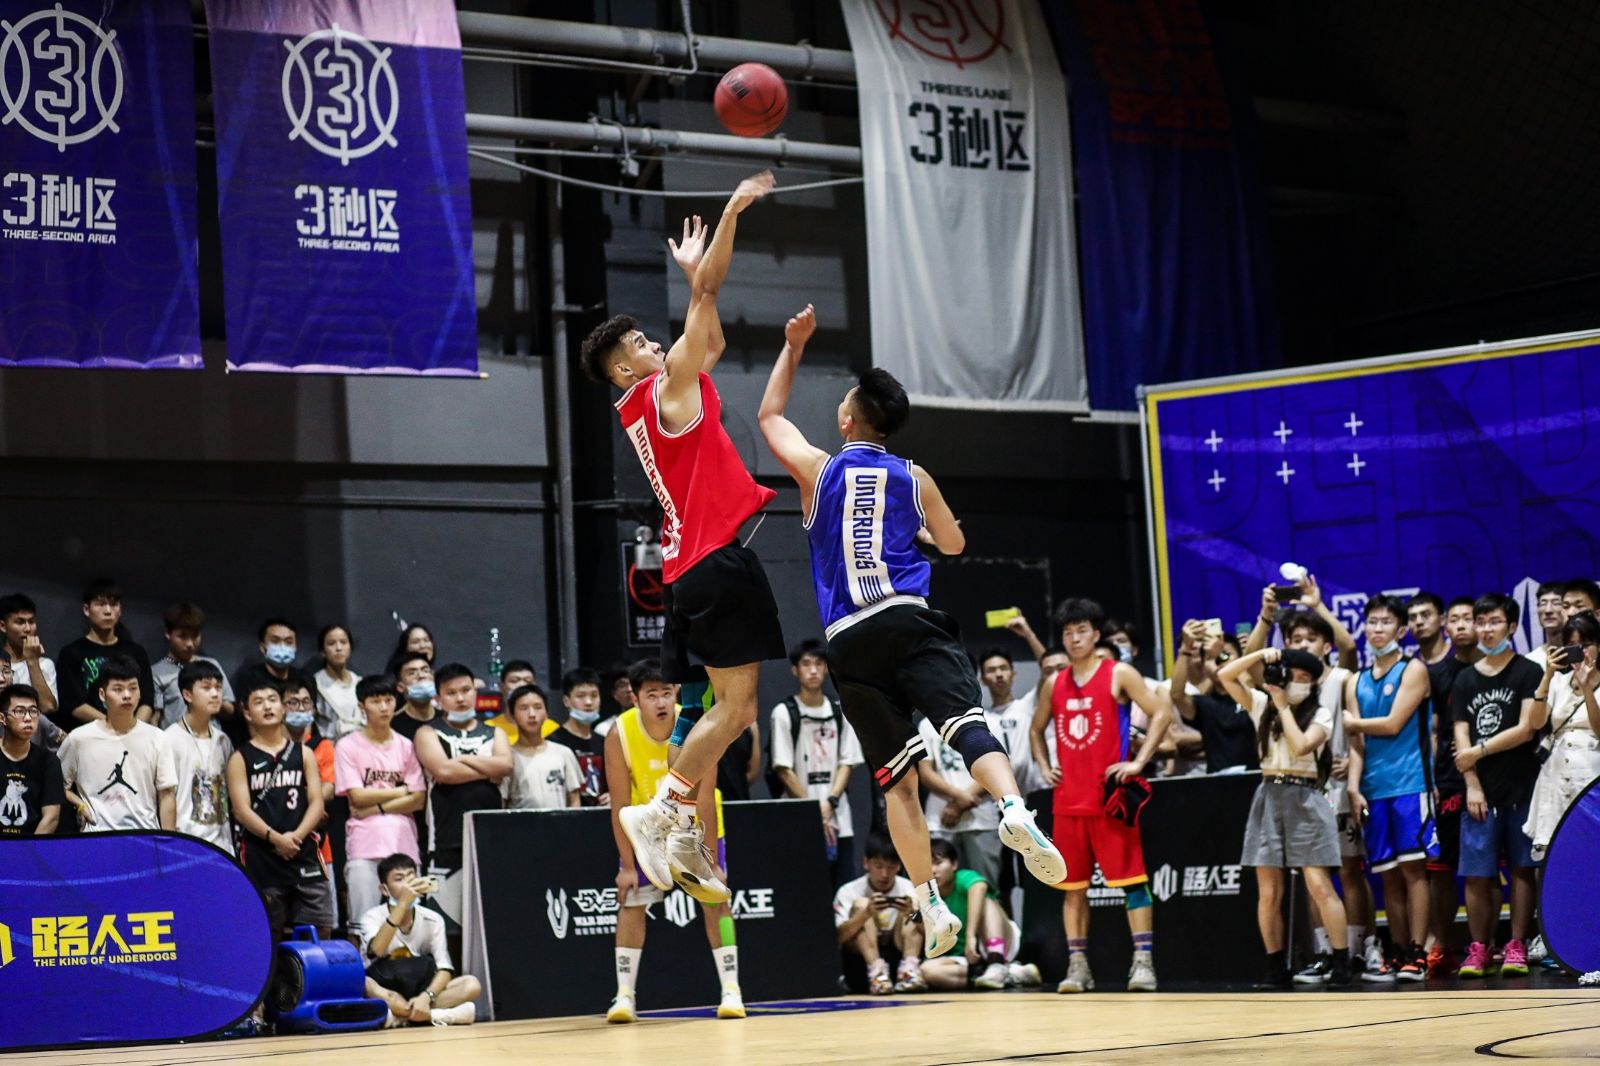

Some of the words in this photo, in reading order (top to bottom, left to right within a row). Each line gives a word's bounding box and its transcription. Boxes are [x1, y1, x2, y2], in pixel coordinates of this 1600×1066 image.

[909, 101, 1031, 171] 3秒区
[3, 172, 117, 230] 3秒区
[294, 184, 400, 240] 3秒区
[2, 229, 84, 242] THREE-SECOND
[87, 233, 117, 244] AREA
[297, 237, 371, 252] THREE-SECOND
[373, 241, 400, 253] AREA
[635, 424, 676, 518] UNDERDOG
[852, 474, 878, 570] UNDERDOGS
[286, 788, 299, 810] 3
[1182, 864, 1243, 891] 路人王
[728, 888, 775, 914] 人王
[31, 910, 177, 958] 路人王
[33, 958, 56, 967] THE
[59, 955, 88, 966] KING
[90, 955, 106, 964] OF
[108, 951, 178, 963] UNDERDOGS
